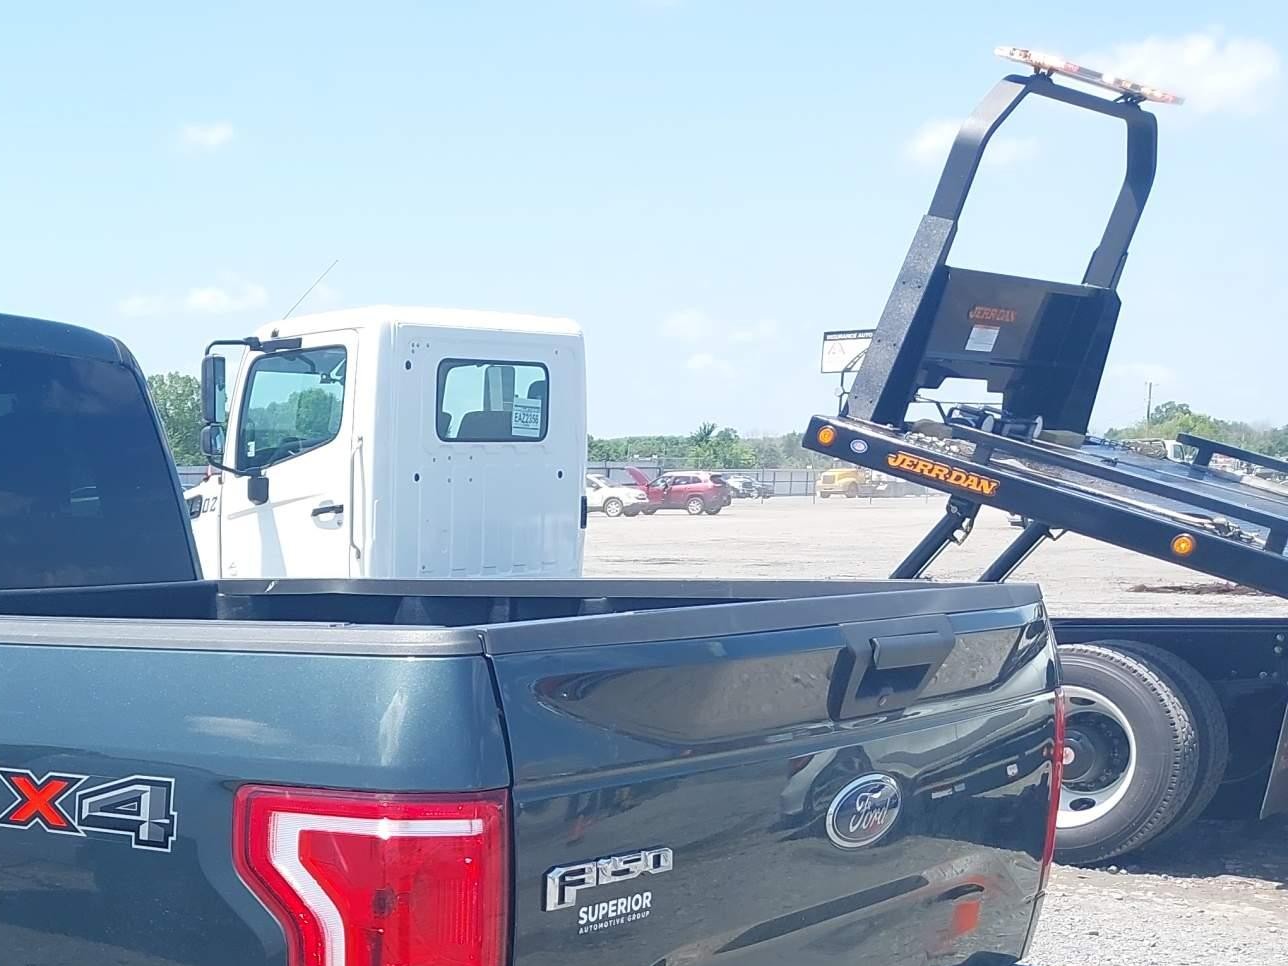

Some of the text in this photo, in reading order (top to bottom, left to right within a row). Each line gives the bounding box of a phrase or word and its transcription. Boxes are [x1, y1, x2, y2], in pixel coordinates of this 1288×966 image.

[849, 789, 892, 833] Ford
[578, 891, 652, 925] SUPERIOR
[578, 910, 650, 935] AUTOMOTIVE GROUP
